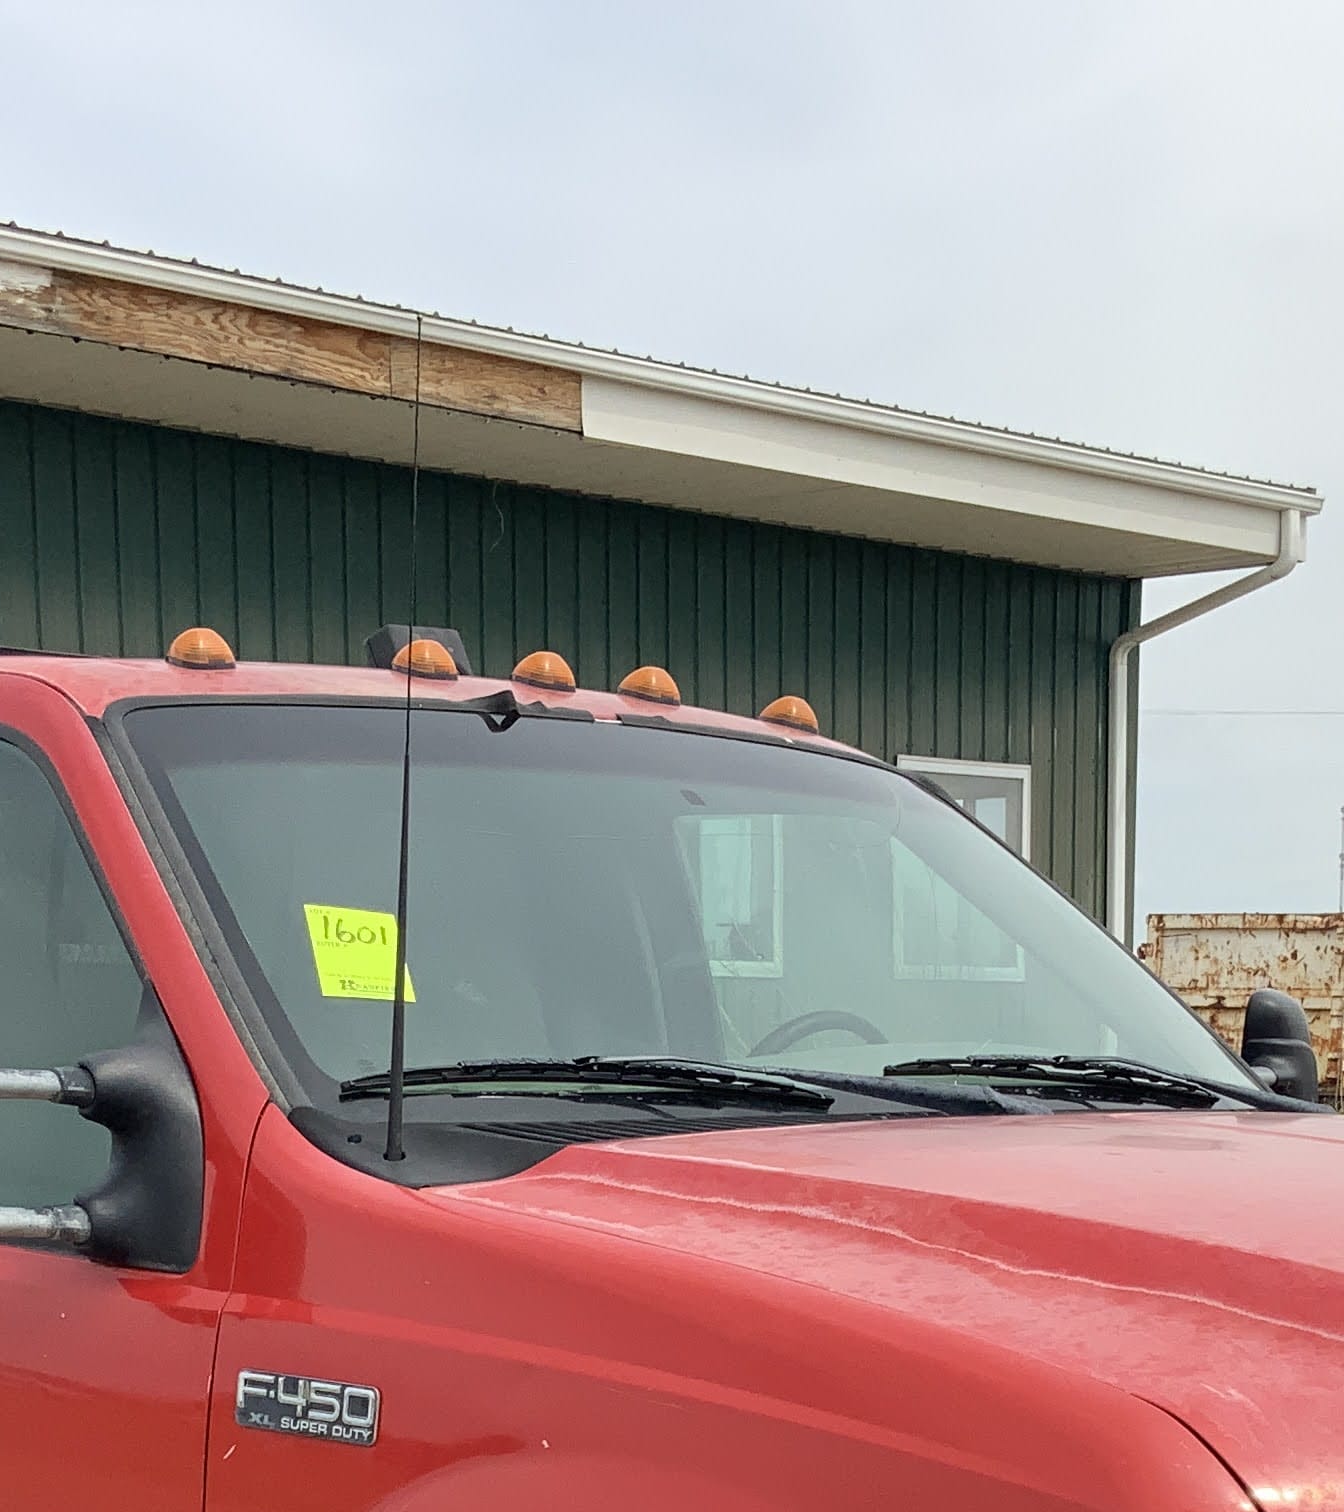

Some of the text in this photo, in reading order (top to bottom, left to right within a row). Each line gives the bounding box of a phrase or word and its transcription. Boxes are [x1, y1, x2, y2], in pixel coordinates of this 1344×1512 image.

[322, 915, 387, 945] 1601
[237, 1371, 375, 1427] F-450
[248, 1411, 276, 1425] XL
[280, 1416, 373, 1442] SUPER DUTY
